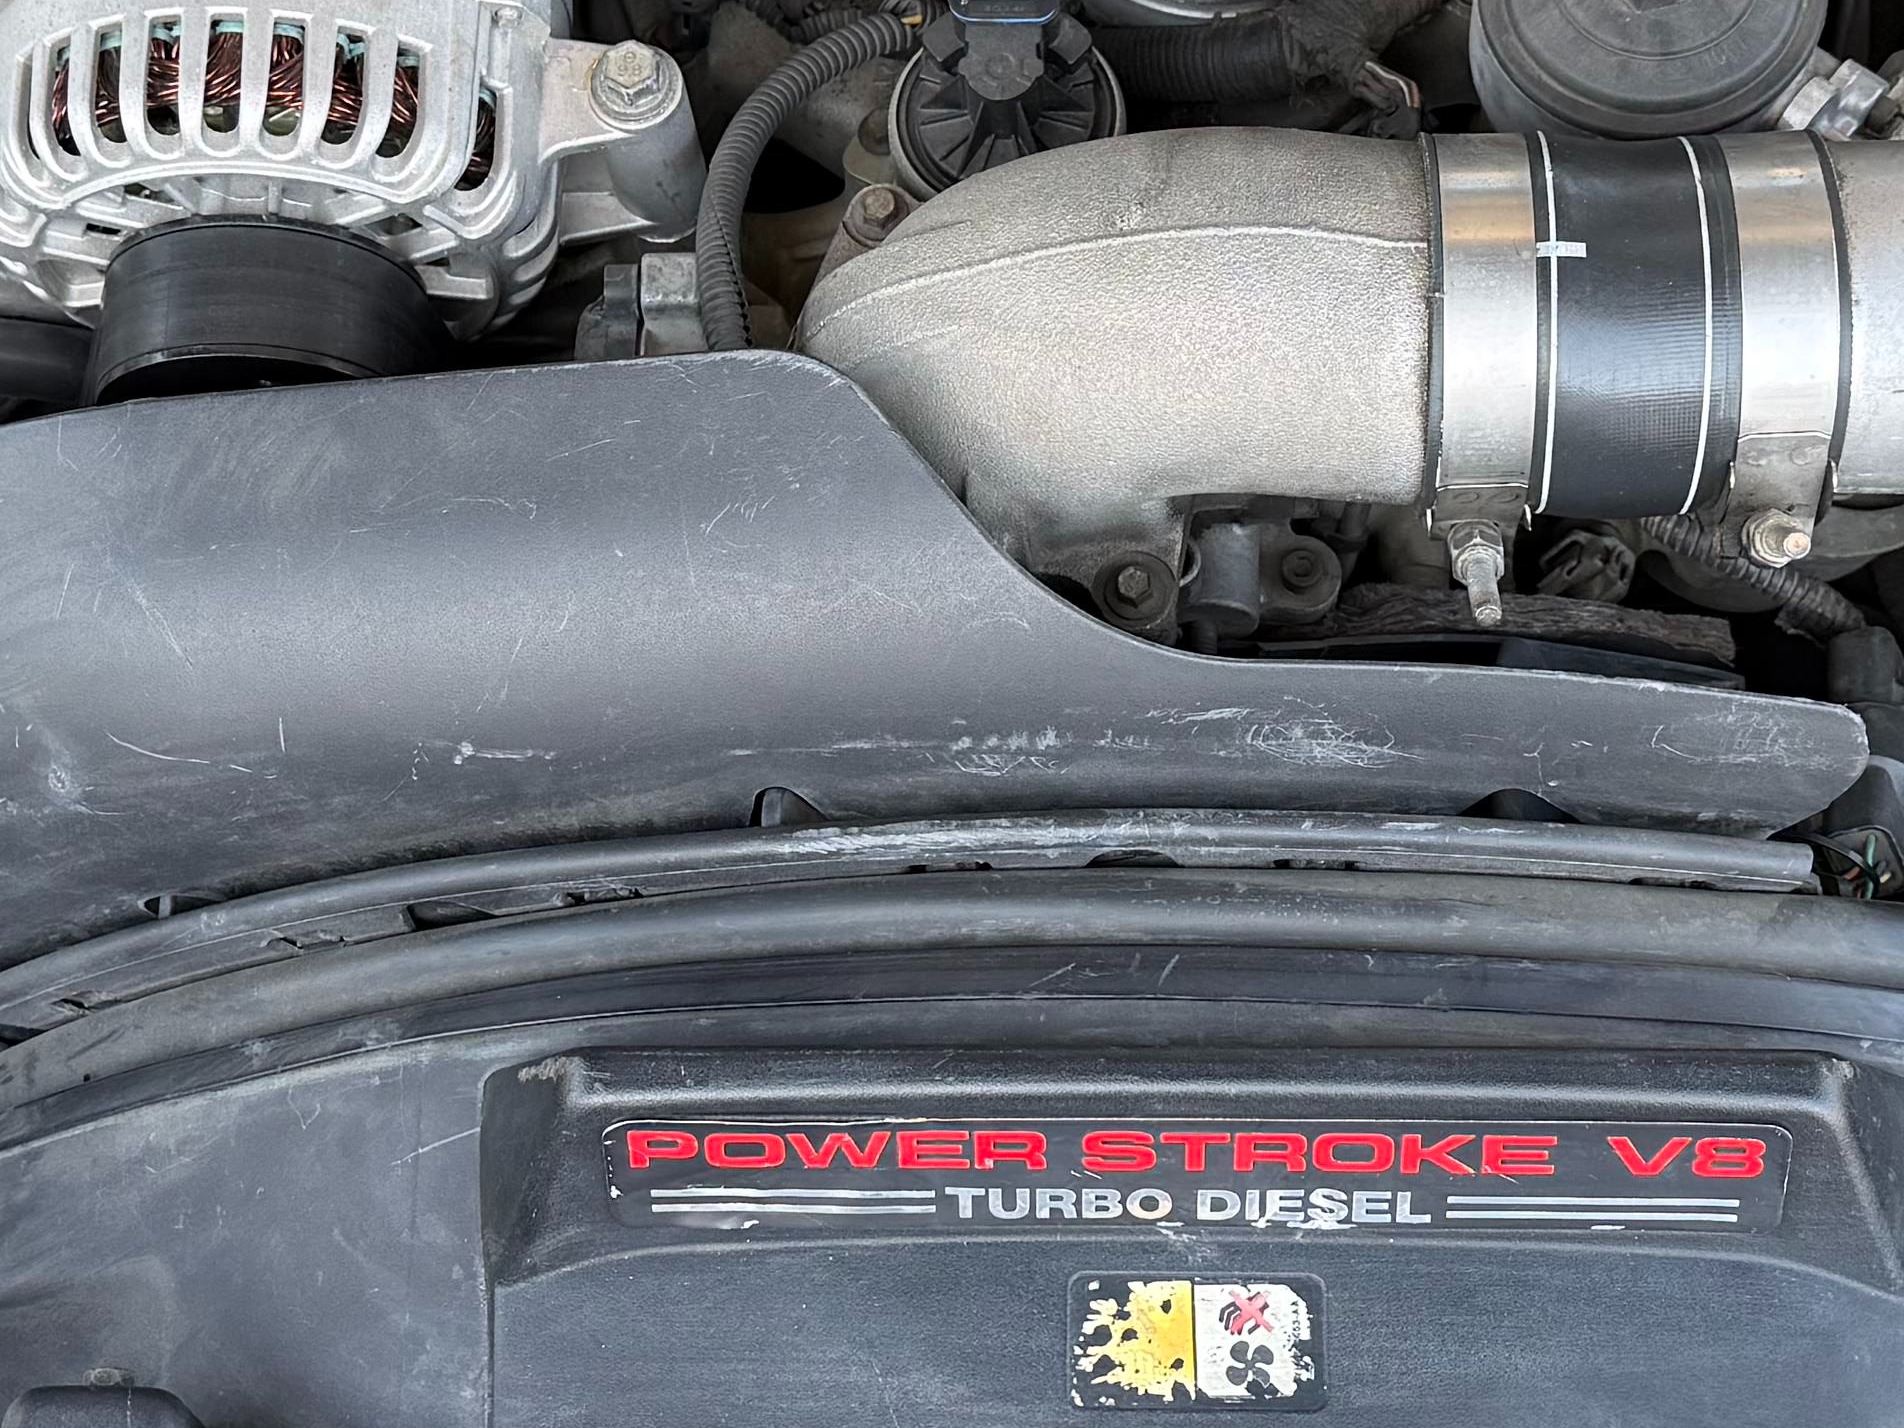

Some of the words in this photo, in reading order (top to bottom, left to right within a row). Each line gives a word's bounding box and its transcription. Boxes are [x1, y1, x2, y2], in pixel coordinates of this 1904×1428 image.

[626, 1129, 1049, 1172] POWER
[1081, 1130, 1558, 1175] STROKE
[1606, 1134, 1769, 1180] V8
[946, 1183, 1175, 1222] TURBO
[1197, 1188, 1433, 1226] DIESEL
